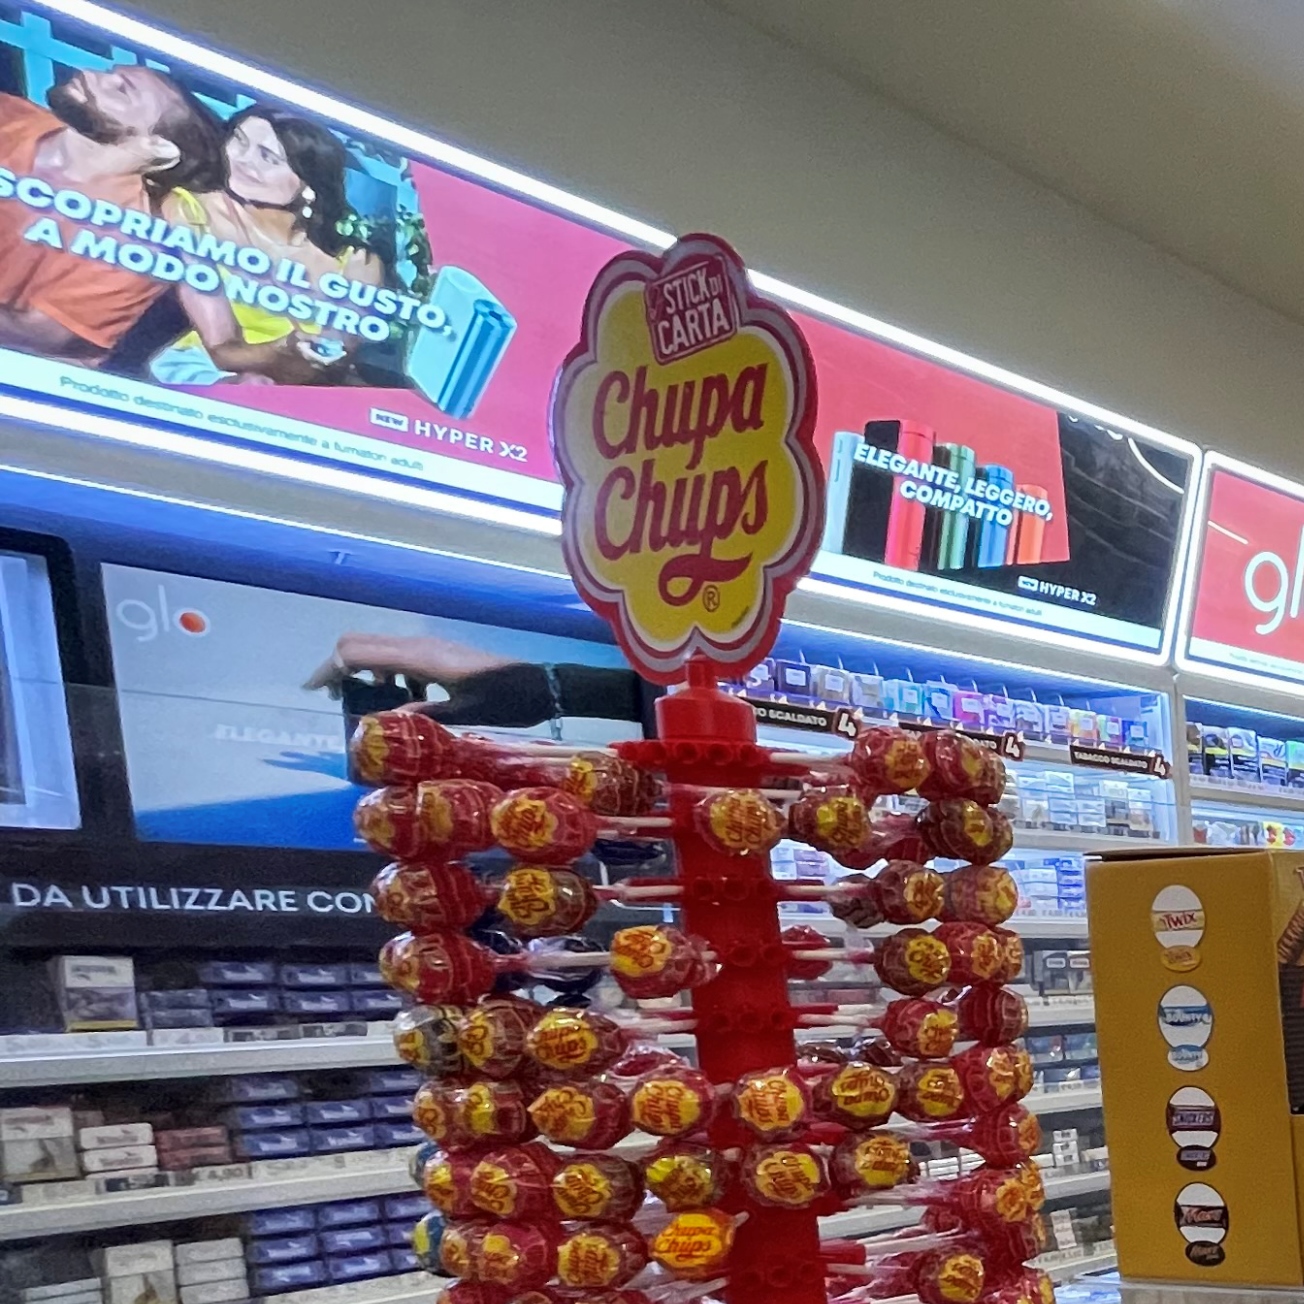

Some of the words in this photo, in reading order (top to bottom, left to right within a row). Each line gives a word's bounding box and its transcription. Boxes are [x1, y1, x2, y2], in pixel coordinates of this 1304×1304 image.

[0, 167, 271, 276] SCOPRIAMO
[277, 258, 311, 288] IL
[318, 271, 454, 337] GUSTO,
[24, 217, 63, 250] A
[71, 231, 220, 293] MODO
[224, 275, 391, 342] NOSTRO
[663, 267, 709, 314] STICK
[709, 276, 723, 294] DI
[656, 299, 730, 356] CARTA
[592, 362, 769, 470] Chupa
[414, 419, 495, 454] HYPER
[499, 440, 529, 463] X2
[853, 442, 962, 494] ELEGANTE,
[964, 477, 1054, 522] LEGGERO,
[899, 481, 1014, 527] COMPATTO
[594, 459, 769, 607] Chups
[116, 585, 211, 643] glo
[1039, 581, 1079, 601] HYPER
[768, 708, 829, 728] SCALDATO
[836, 711, 856, 736] 4
[1005, 735, 1021, 758] 4
[1074, 750, 1108, 764] TABACCO
[1109, 756, 1149, 770] SCALDATO
[12, 883, 72, 910] DA
[78, 884, 296, 914] UTILIZZARE
